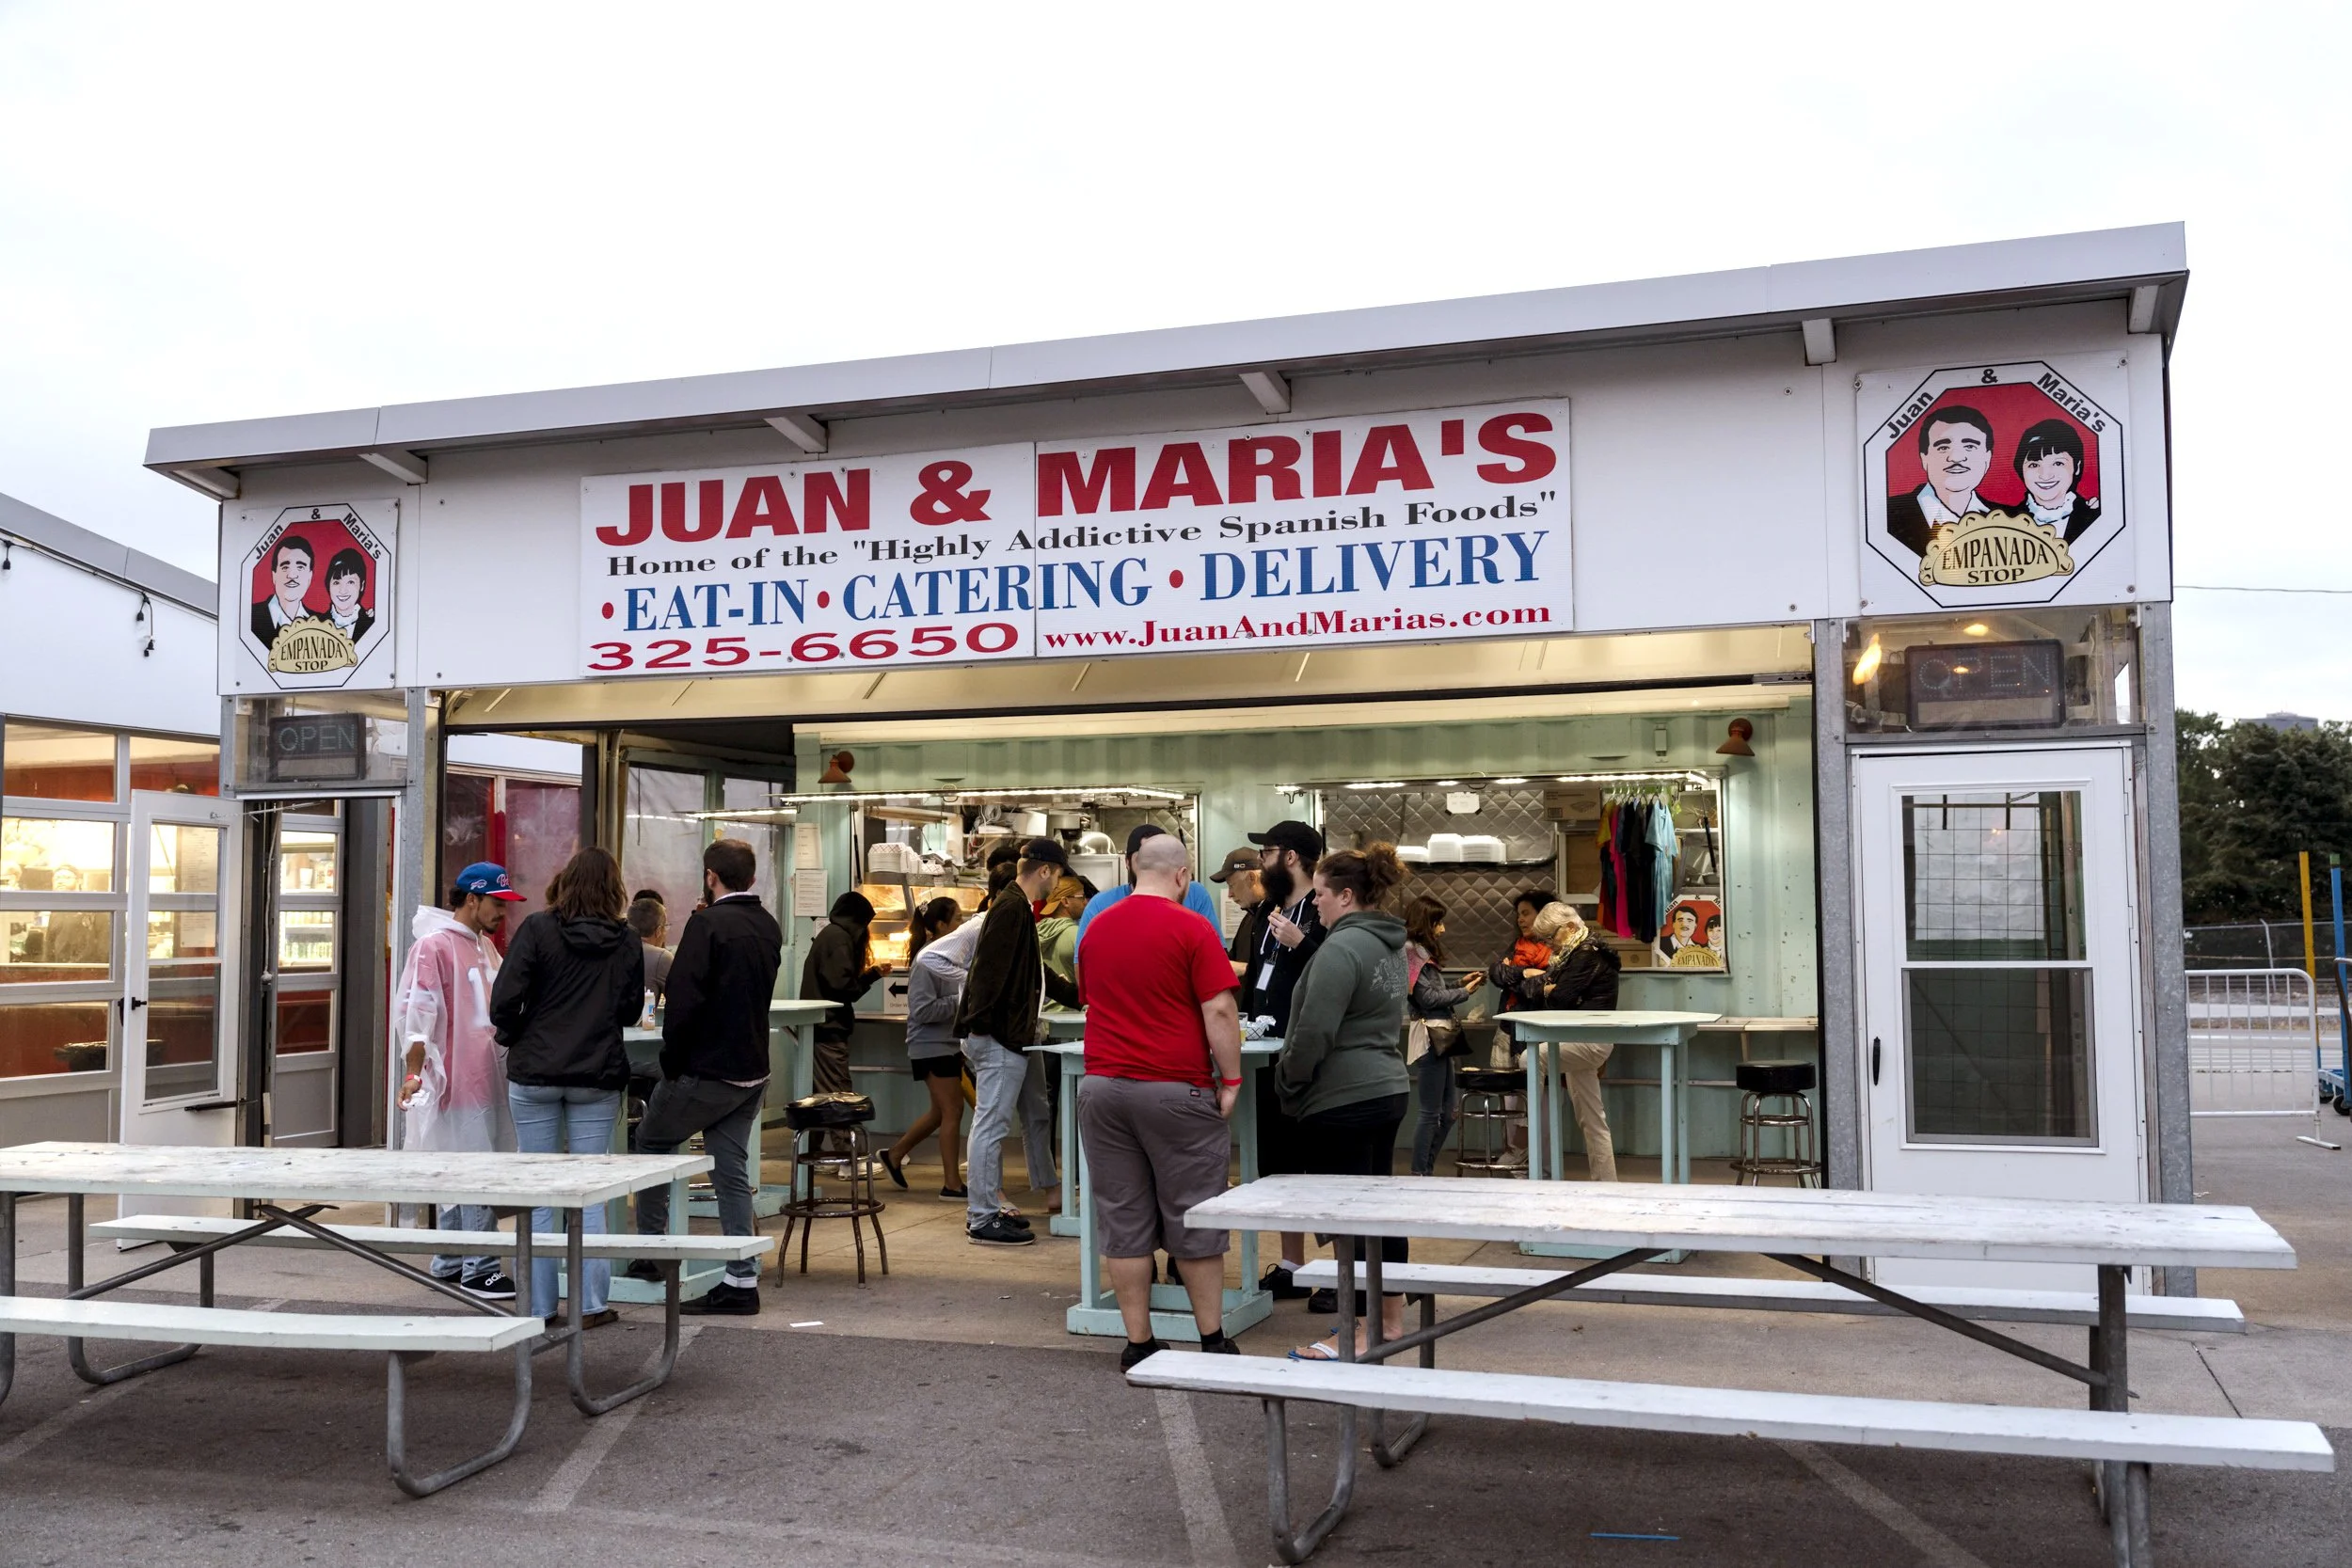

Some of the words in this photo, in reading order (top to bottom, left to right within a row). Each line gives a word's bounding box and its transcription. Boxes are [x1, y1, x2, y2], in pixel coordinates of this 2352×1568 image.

[1888, 391, 1934, 440] Juan
[1980, 368, 1998, 384] &
[2037, 372, 2106, 434] Maria's
[596, 468, 870, 546] JUAN
[909, 460, 992, 527] &
[1037, 412, 1557, 517] MARIA'S
[255, 524, 284, 560] Juan
[310, 508, 322, 520] &
[342, 512, 382, 560] Maria's
[607, 556, 716, 577] Home
[731, 547, 771, 569] of
[781, 546, 839, 567] the
[1008, 522, 1202, 551] Addictive
[1219, 515, 1388, 544] Spanish
[1941, 536, 2050, 571] EMPANADA
[623, 578, 809, 632] EAT-IN
[842, 558, 1152, 622] CATERING
[1199, 530, 1550, 602] DELIVERY
[1967, 568, 2025, 584] STOP
[586, 622, 1020, 672] 325-6650
[1044, 607, 1552, 648] www.JuanAndMarias.com
[280, 635, 343, 661] EMPANADA
[294, 659, 328, 672] STOP
[1918, 653, 2051, 690] OPEN
[278, 723, 356, 752] OPEN
[1664, 900, 1678, 913] uan
